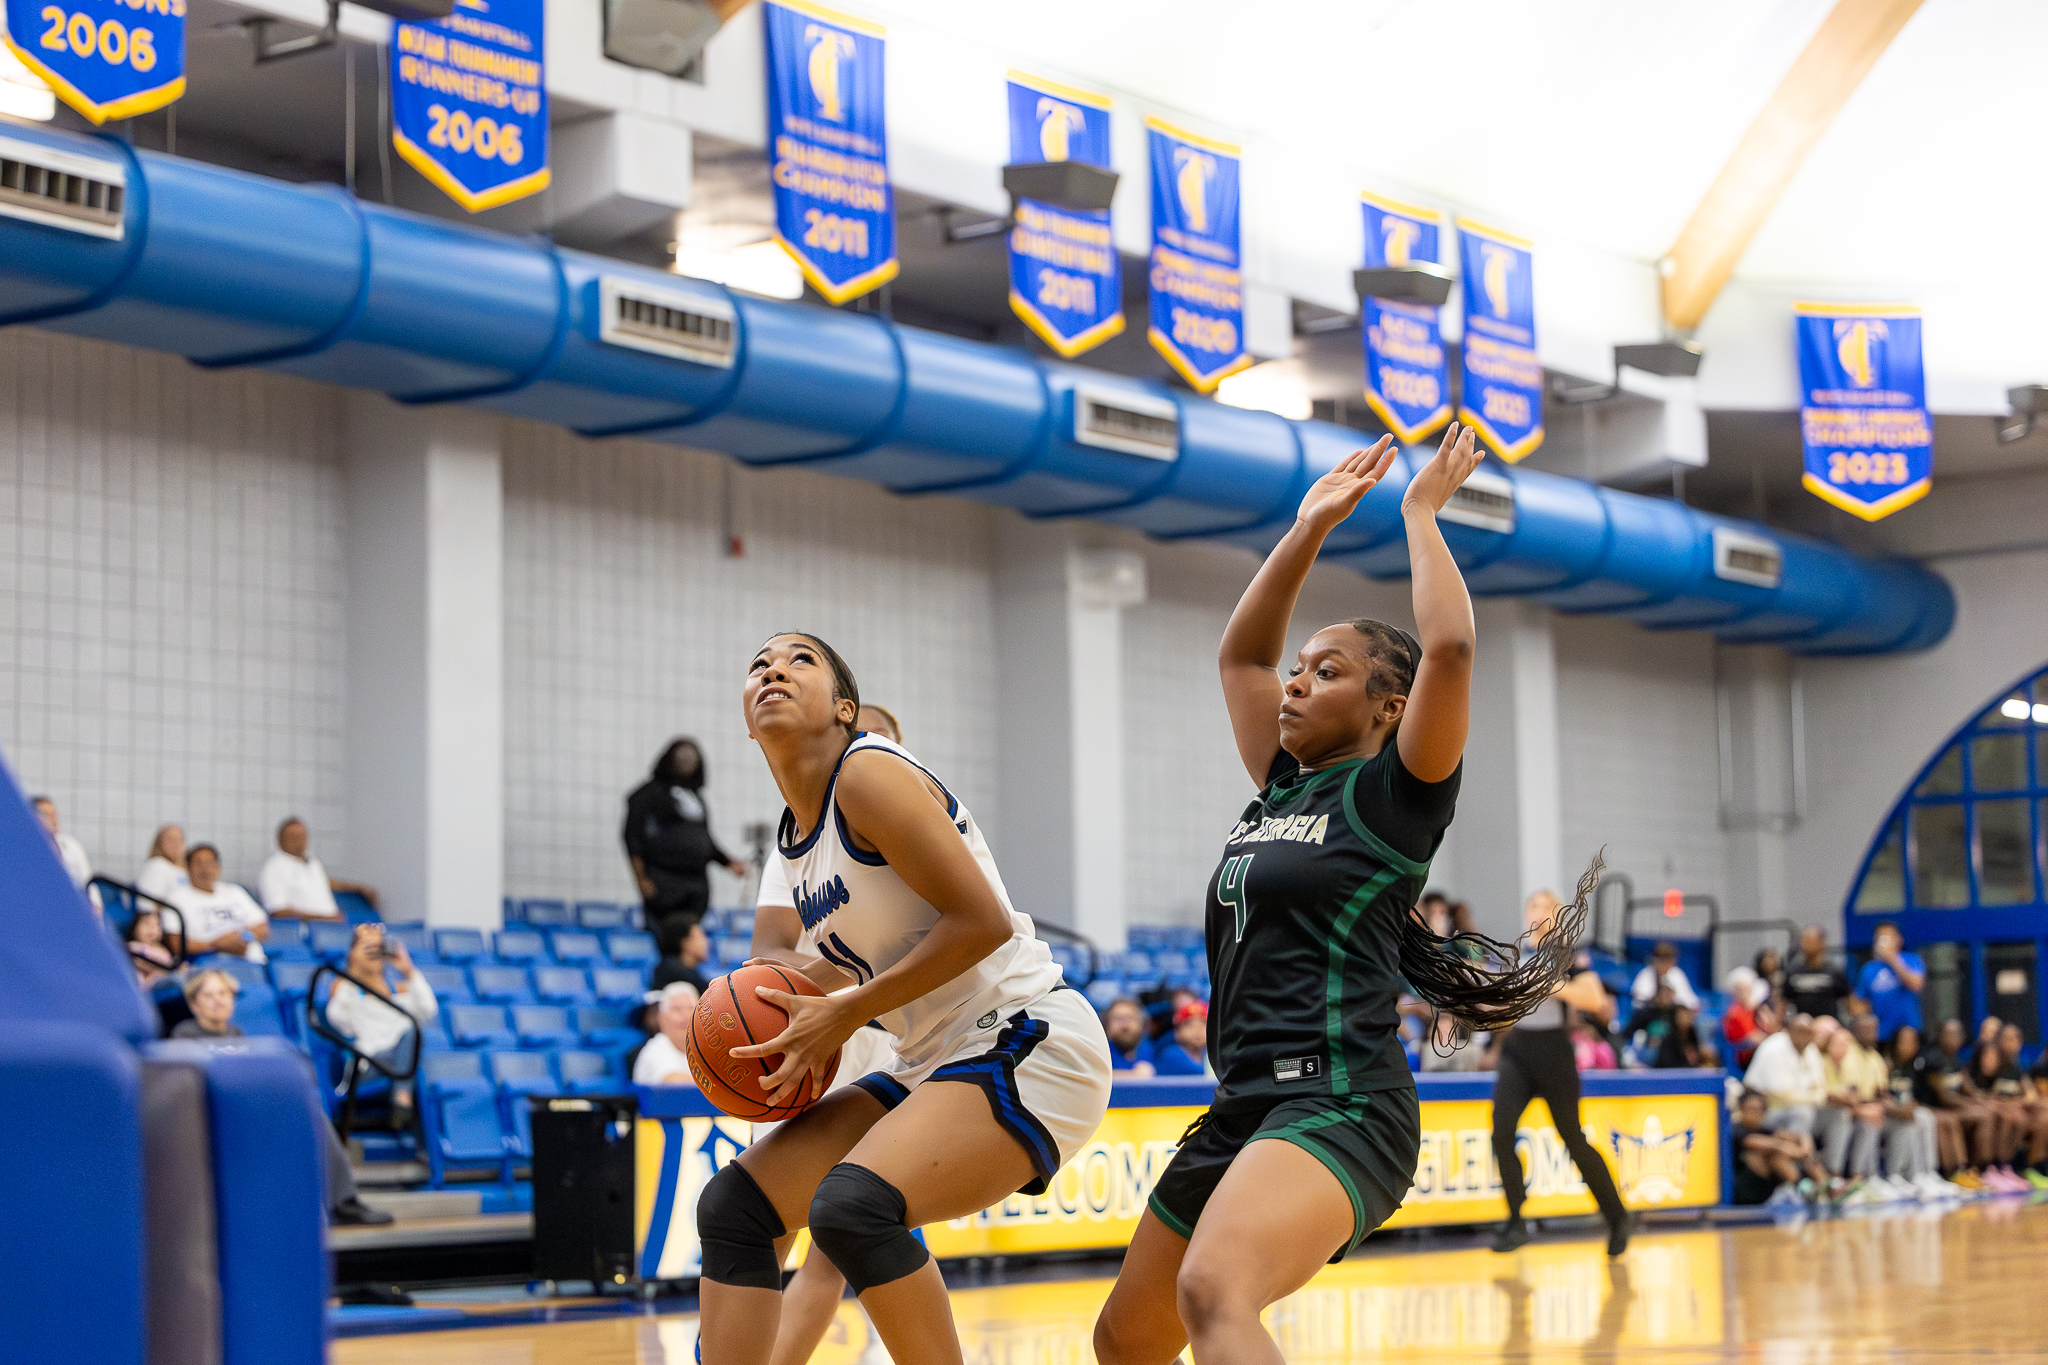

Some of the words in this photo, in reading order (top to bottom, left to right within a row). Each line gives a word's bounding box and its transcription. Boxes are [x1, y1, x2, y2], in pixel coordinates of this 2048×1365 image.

[40, 5, 157, 72] 2006
[427, 103, 524, 166] 2006
[804, 208, 870, 259] 2011
[1038, 267, 1096, 315] 2011
[1827, 451, 1909, 485] 2023
[1217, 853, 1255, 943] 4
[817, 931, 875, 987] 11
[1306, 1062, 1314, 1072] S
